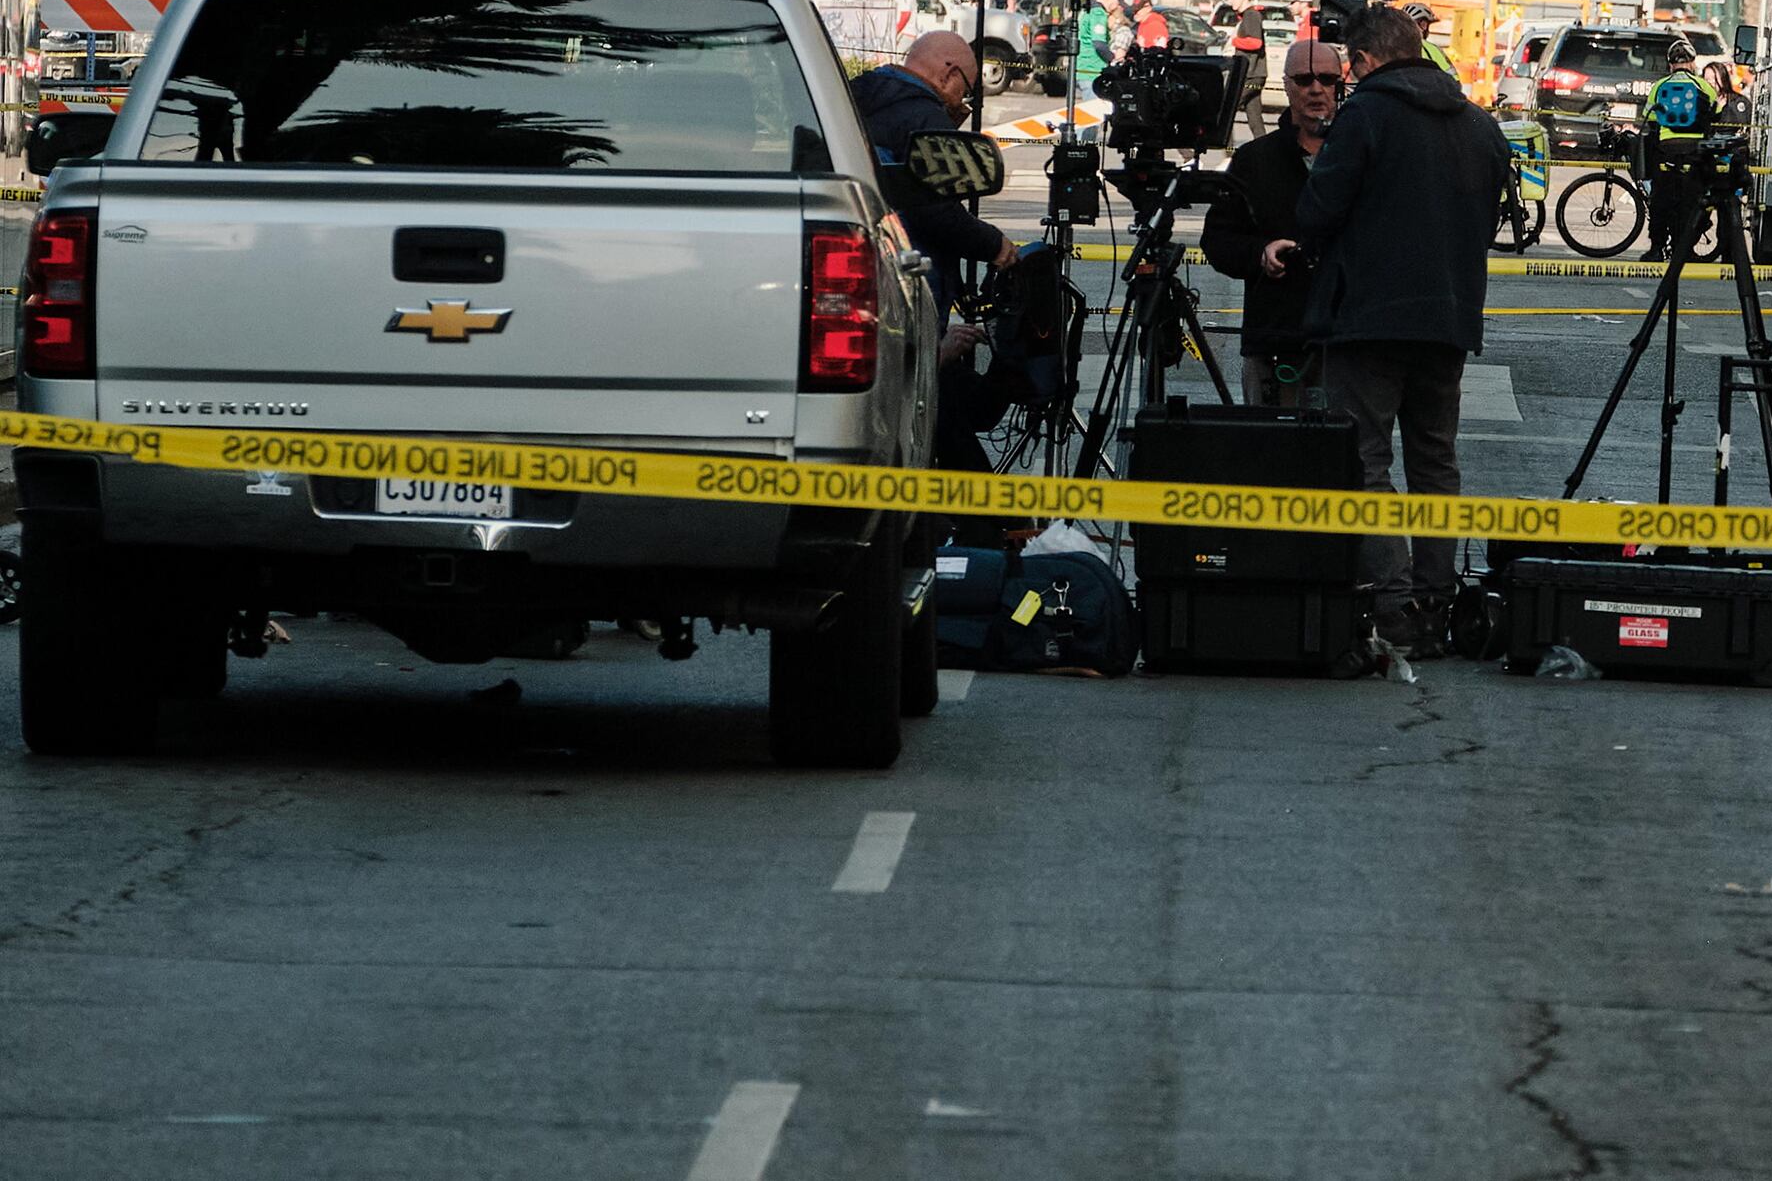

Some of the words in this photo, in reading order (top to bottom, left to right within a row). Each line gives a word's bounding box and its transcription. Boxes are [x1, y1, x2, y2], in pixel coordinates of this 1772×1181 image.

[1526, 262, 1561, 276] POLICE
[1563, 264, 1585, 277] LINE
[1589, 266, 1601, 278] DO
[1604, 266, 1621, 278] NOT
[1627, 266, 1663, 279] CROSS
[122, 400, 309, 416] SILVERADO
[746, 410, 770, 424] LT
[1607, 603, 1657, 614] PROMPTER
[1662, 606, 1699, 616] PEOPLE
[1627, 629, 1660, 638] GLASS
